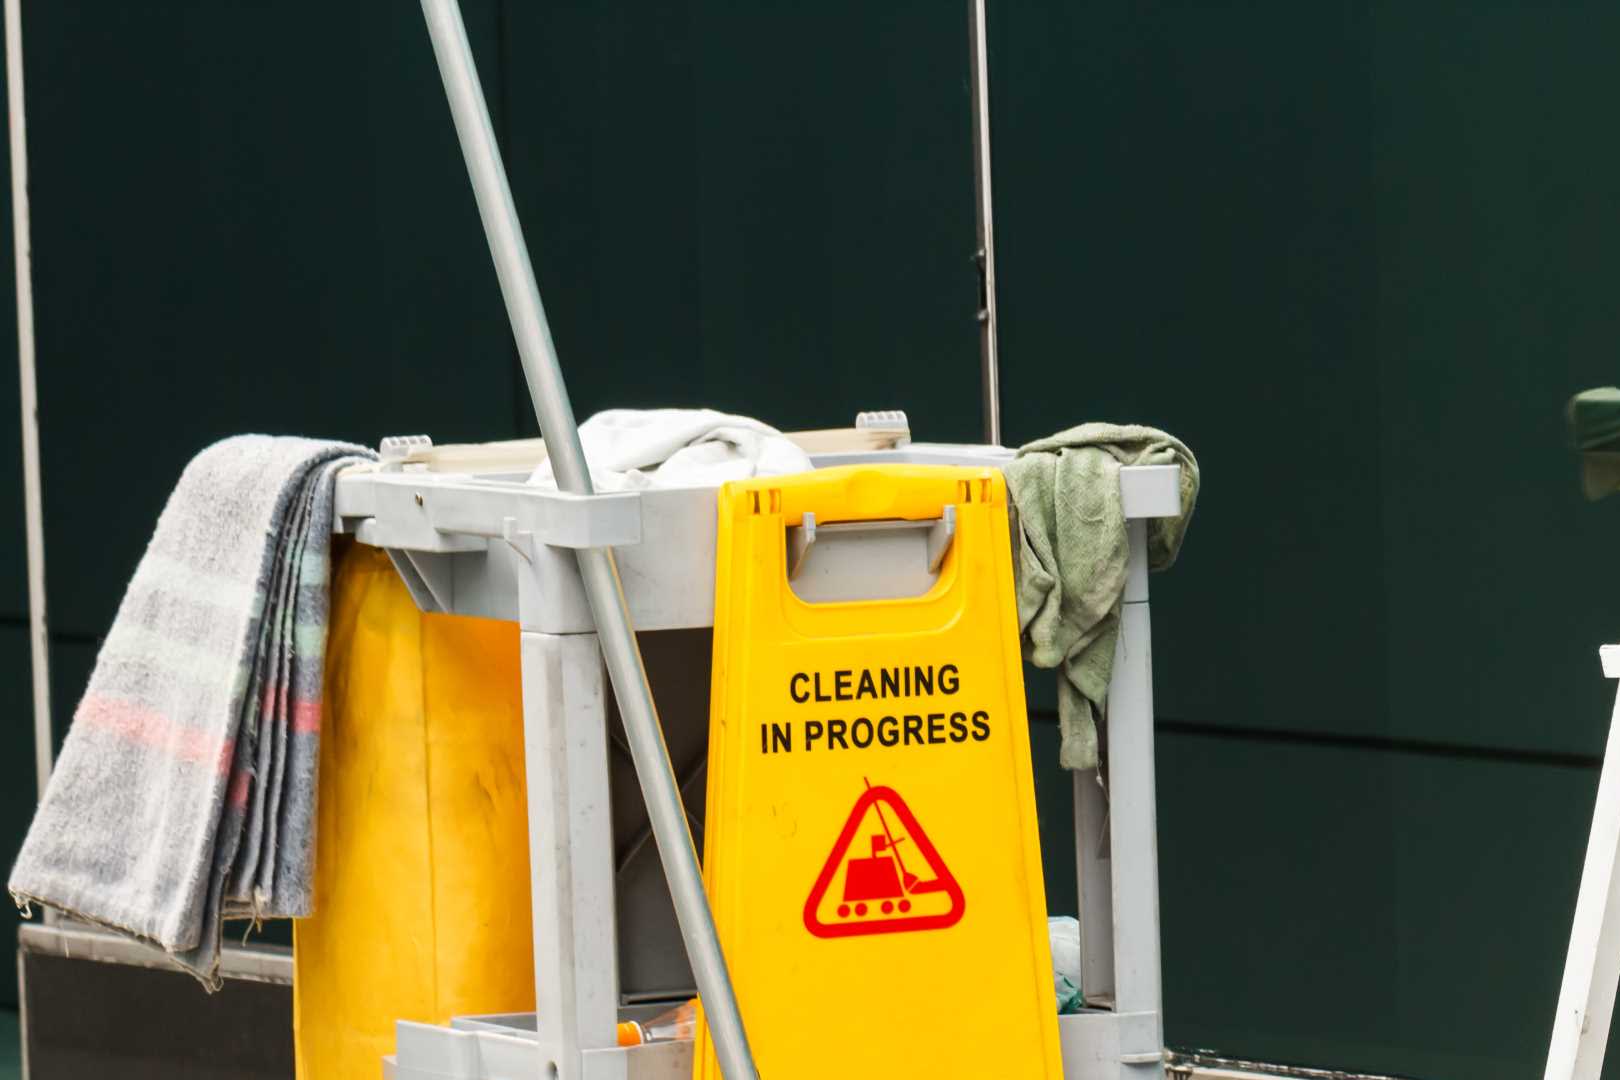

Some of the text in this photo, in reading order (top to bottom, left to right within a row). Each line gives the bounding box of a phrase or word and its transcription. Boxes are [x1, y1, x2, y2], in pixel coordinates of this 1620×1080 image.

[790, 664, 959, 703] CLEANING
[761, 710, 990, 754] IN PROGRESS
